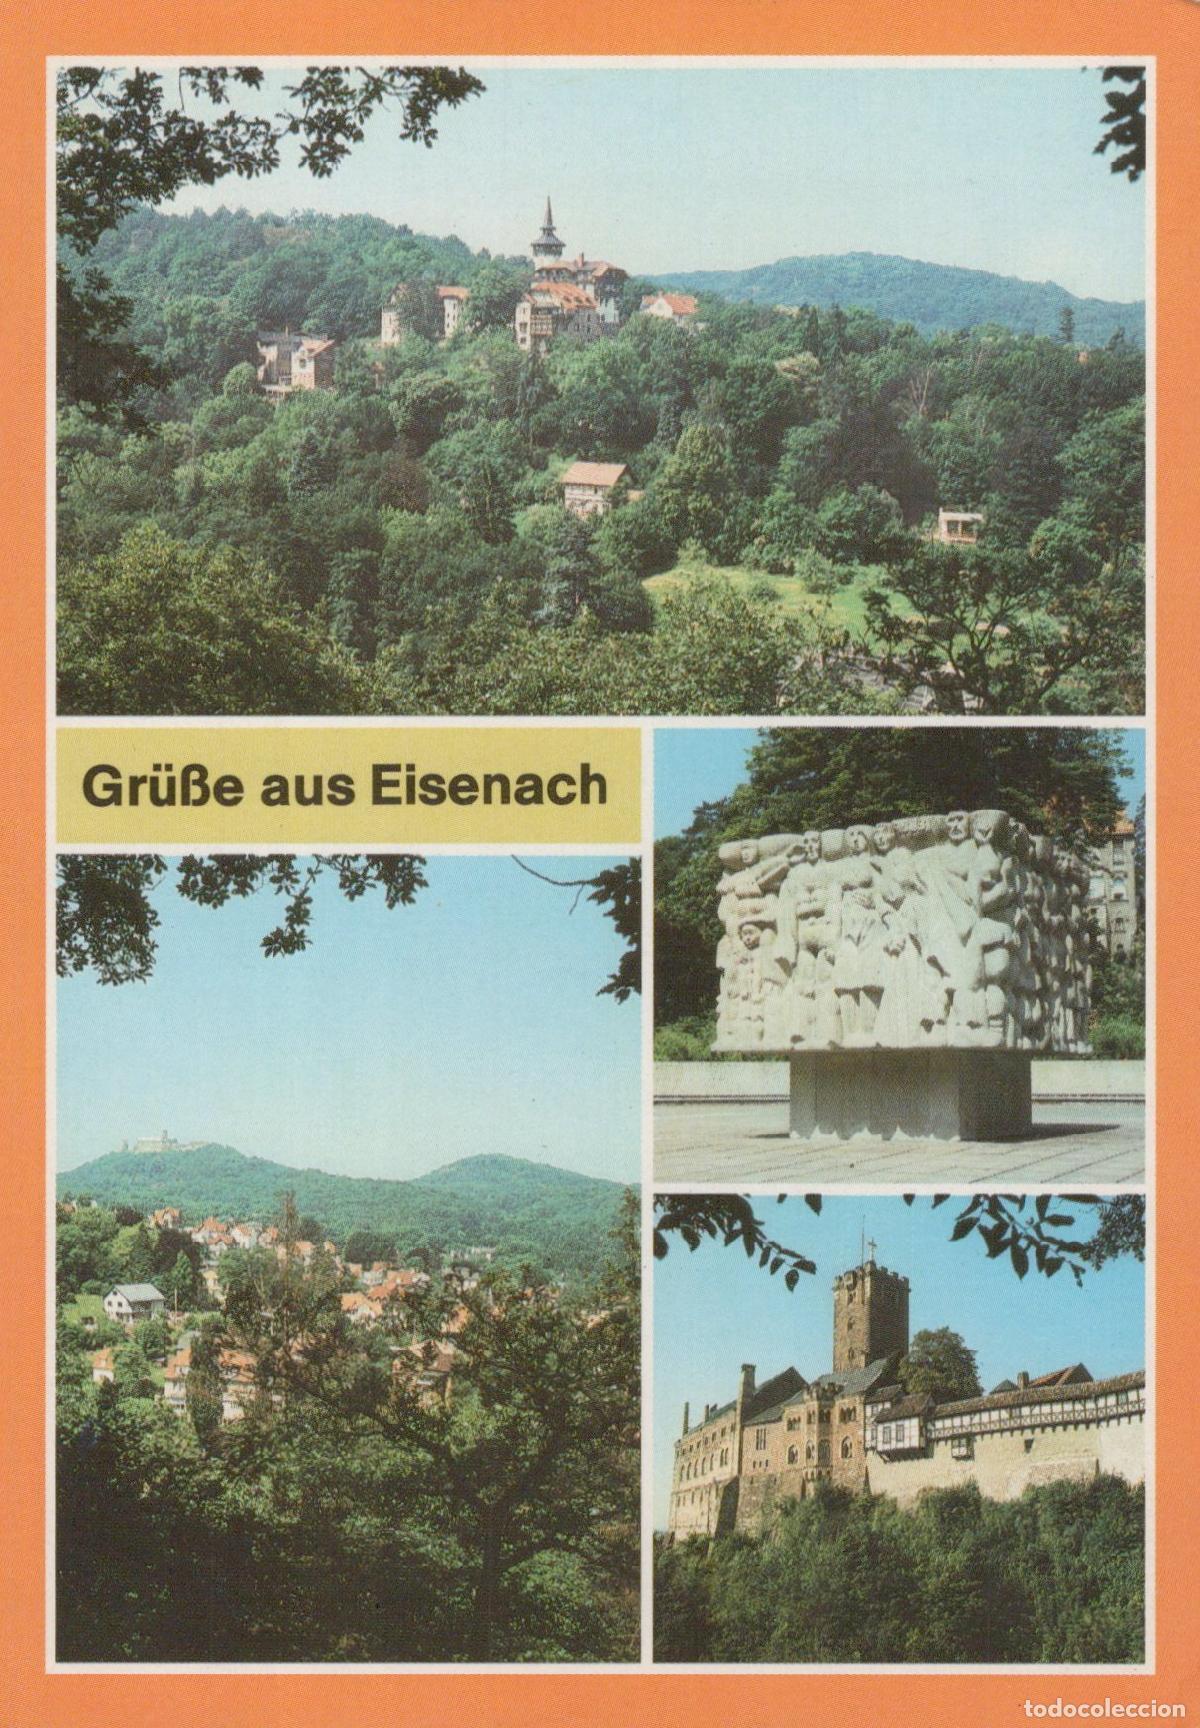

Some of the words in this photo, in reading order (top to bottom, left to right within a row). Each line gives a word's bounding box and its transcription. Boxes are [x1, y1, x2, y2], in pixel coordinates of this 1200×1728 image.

[82, 763, 244, 807] Grüße
[261, 774, 356, 806] aus
[372, 763, 607, 806] Eisenach
